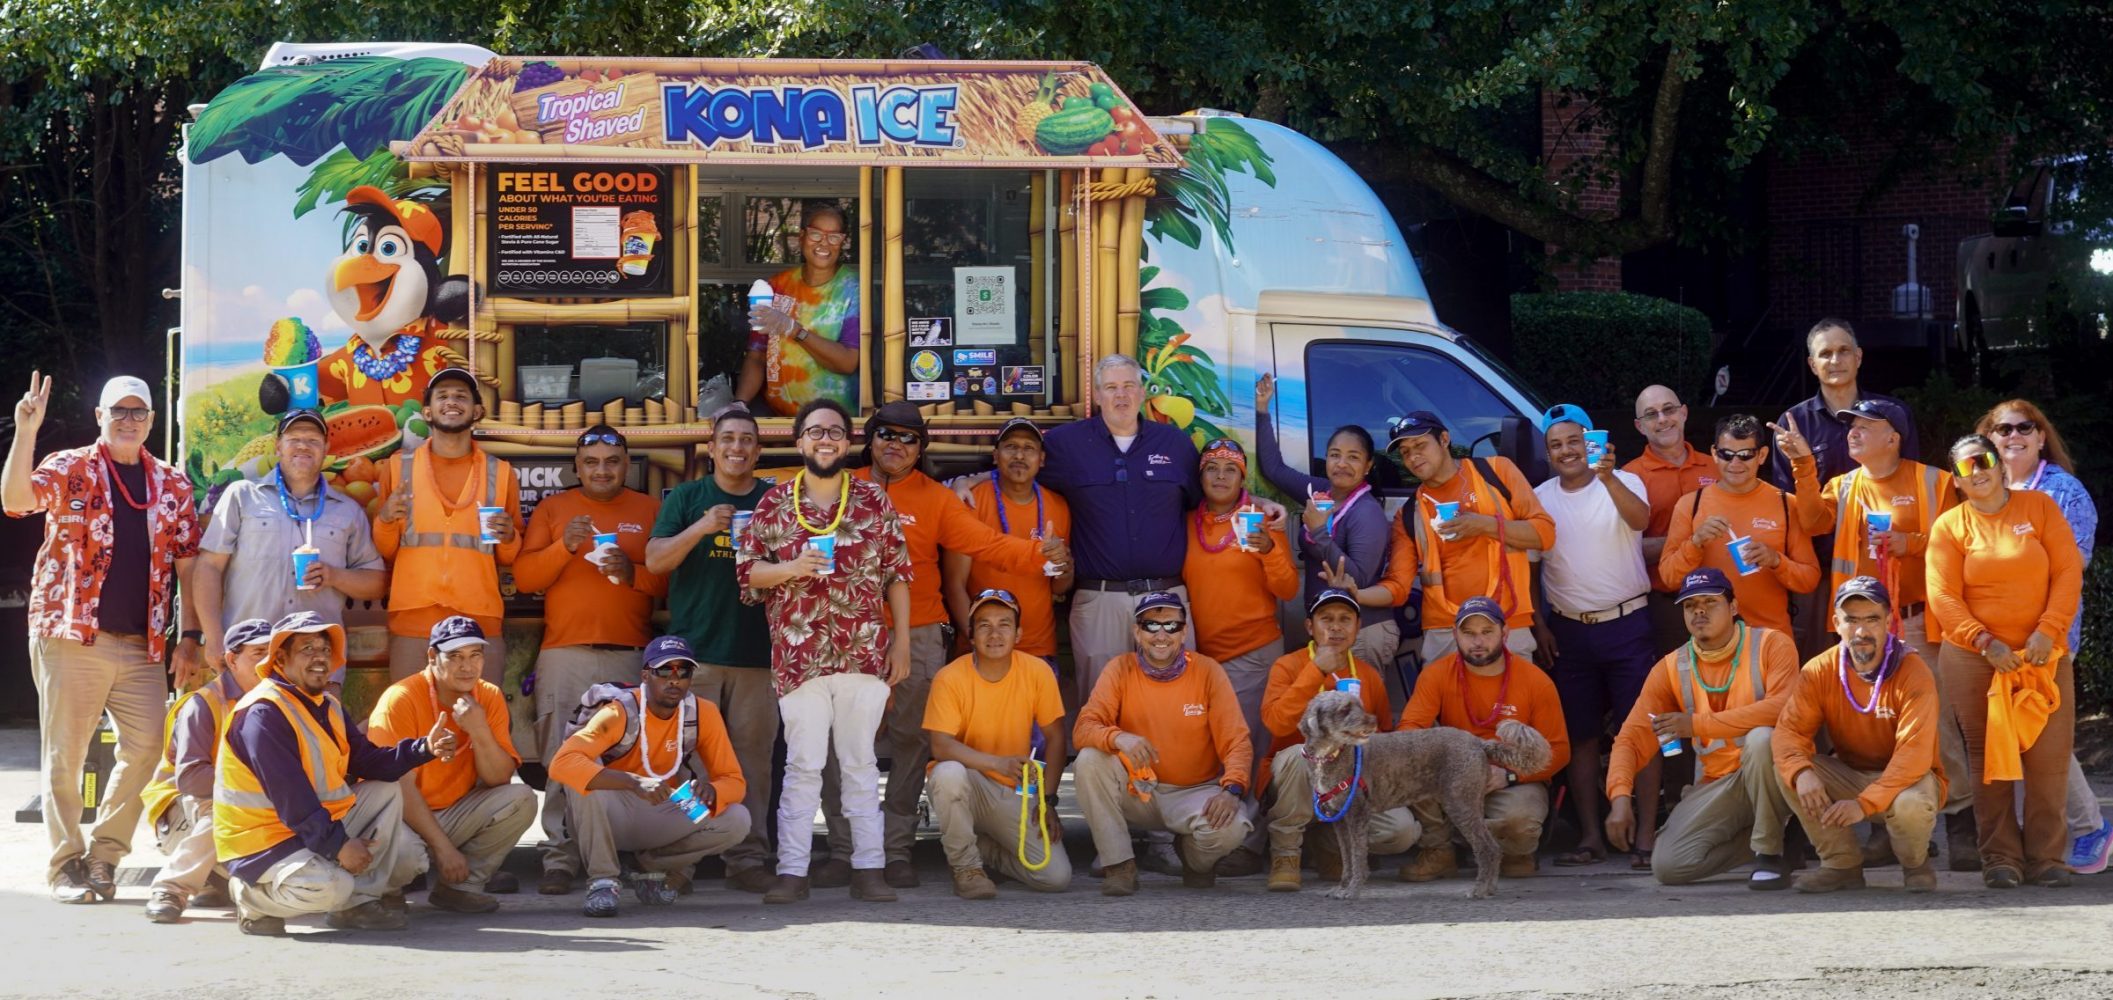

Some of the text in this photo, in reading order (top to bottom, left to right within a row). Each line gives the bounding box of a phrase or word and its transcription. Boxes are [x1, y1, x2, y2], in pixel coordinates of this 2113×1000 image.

[540, 83, 625, 120] Tropical
[565, 107, 645, 142] Shaved
[662, 83, 958, 148] KONA ICE
[498, 171, 658, 193] FEEL GOOD
[498, 194, 658, 203] ABOUT WHAT YOU'RE EATING
[395, 200, 427, 219] T
[498, 214, 538, 222] CALORIES
[968, 351, 994, 359] SMILE
[293, 376, 311, 395] K
